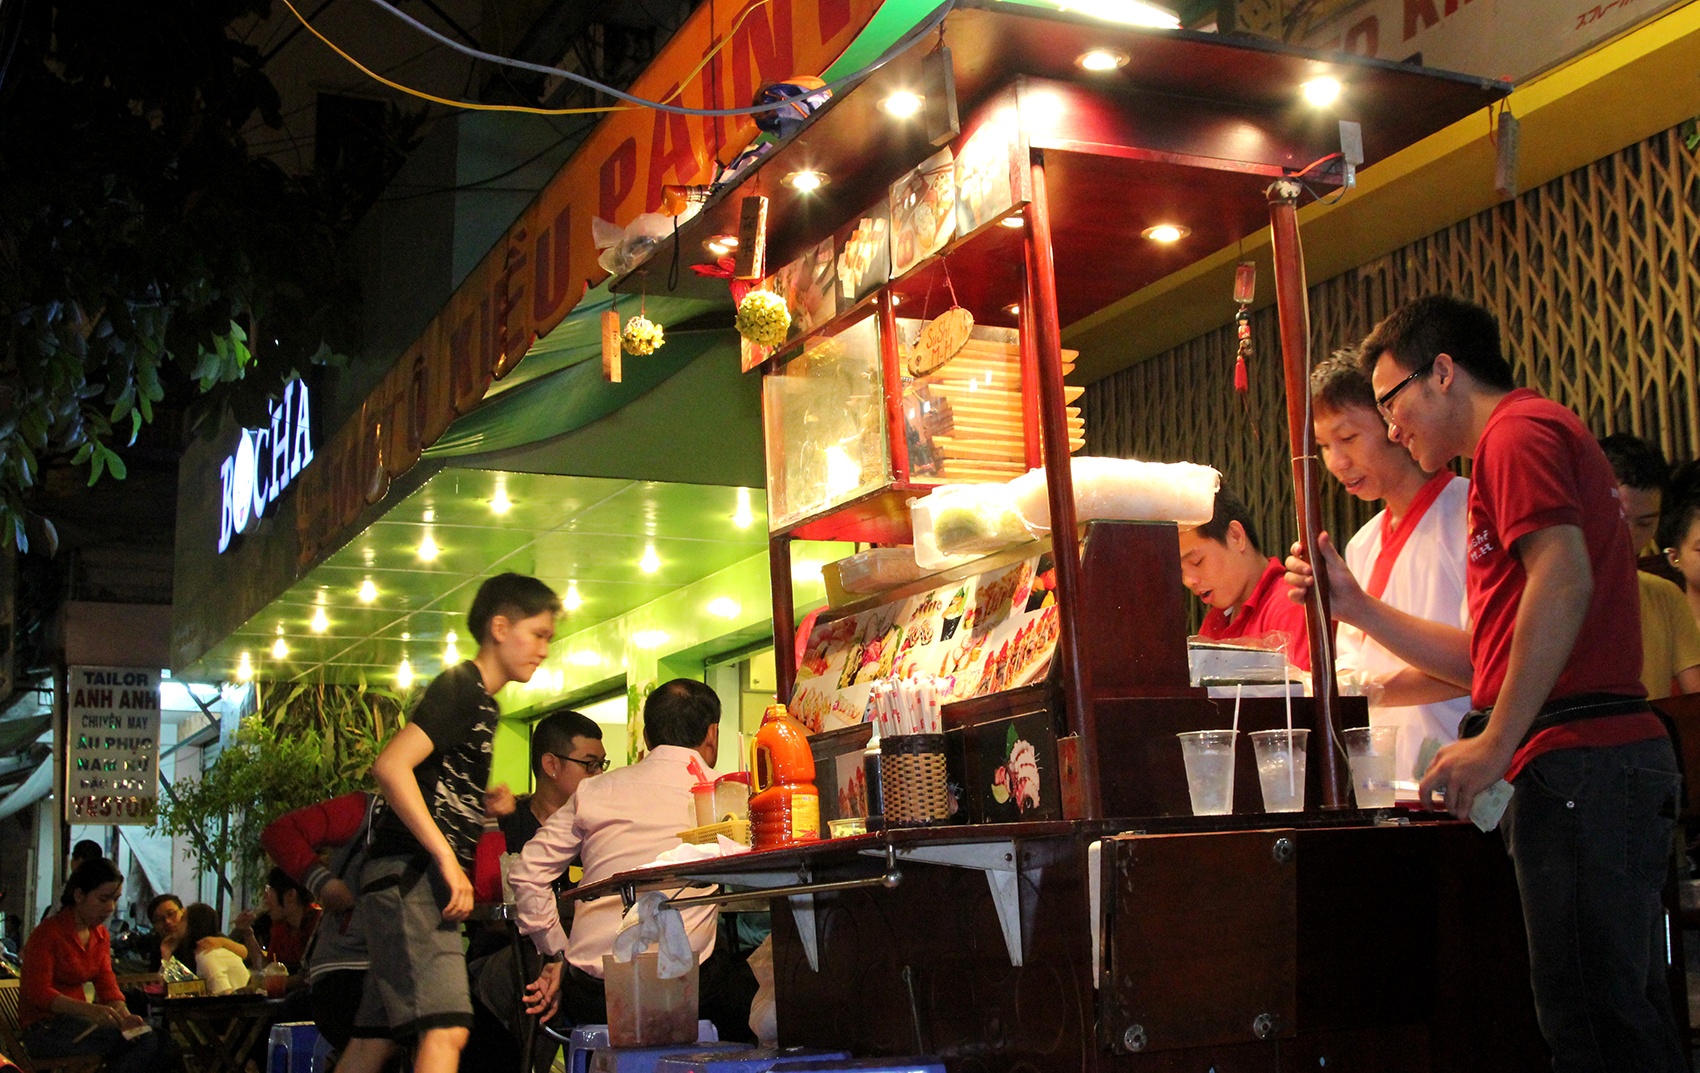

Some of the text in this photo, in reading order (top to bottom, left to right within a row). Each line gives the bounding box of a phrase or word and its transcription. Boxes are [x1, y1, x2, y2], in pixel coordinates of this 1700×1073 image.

[931, 336, 953, 366] M-H
[84, 672, 149, 687] TAILOR
[74, 689, 157, 710] ANH ANH
[82, 712, 148, 729] CHUYÊN MAY
[77, 733, 153, 755] ÂU PHỤC
[77, 758, 117, 771] NAM
